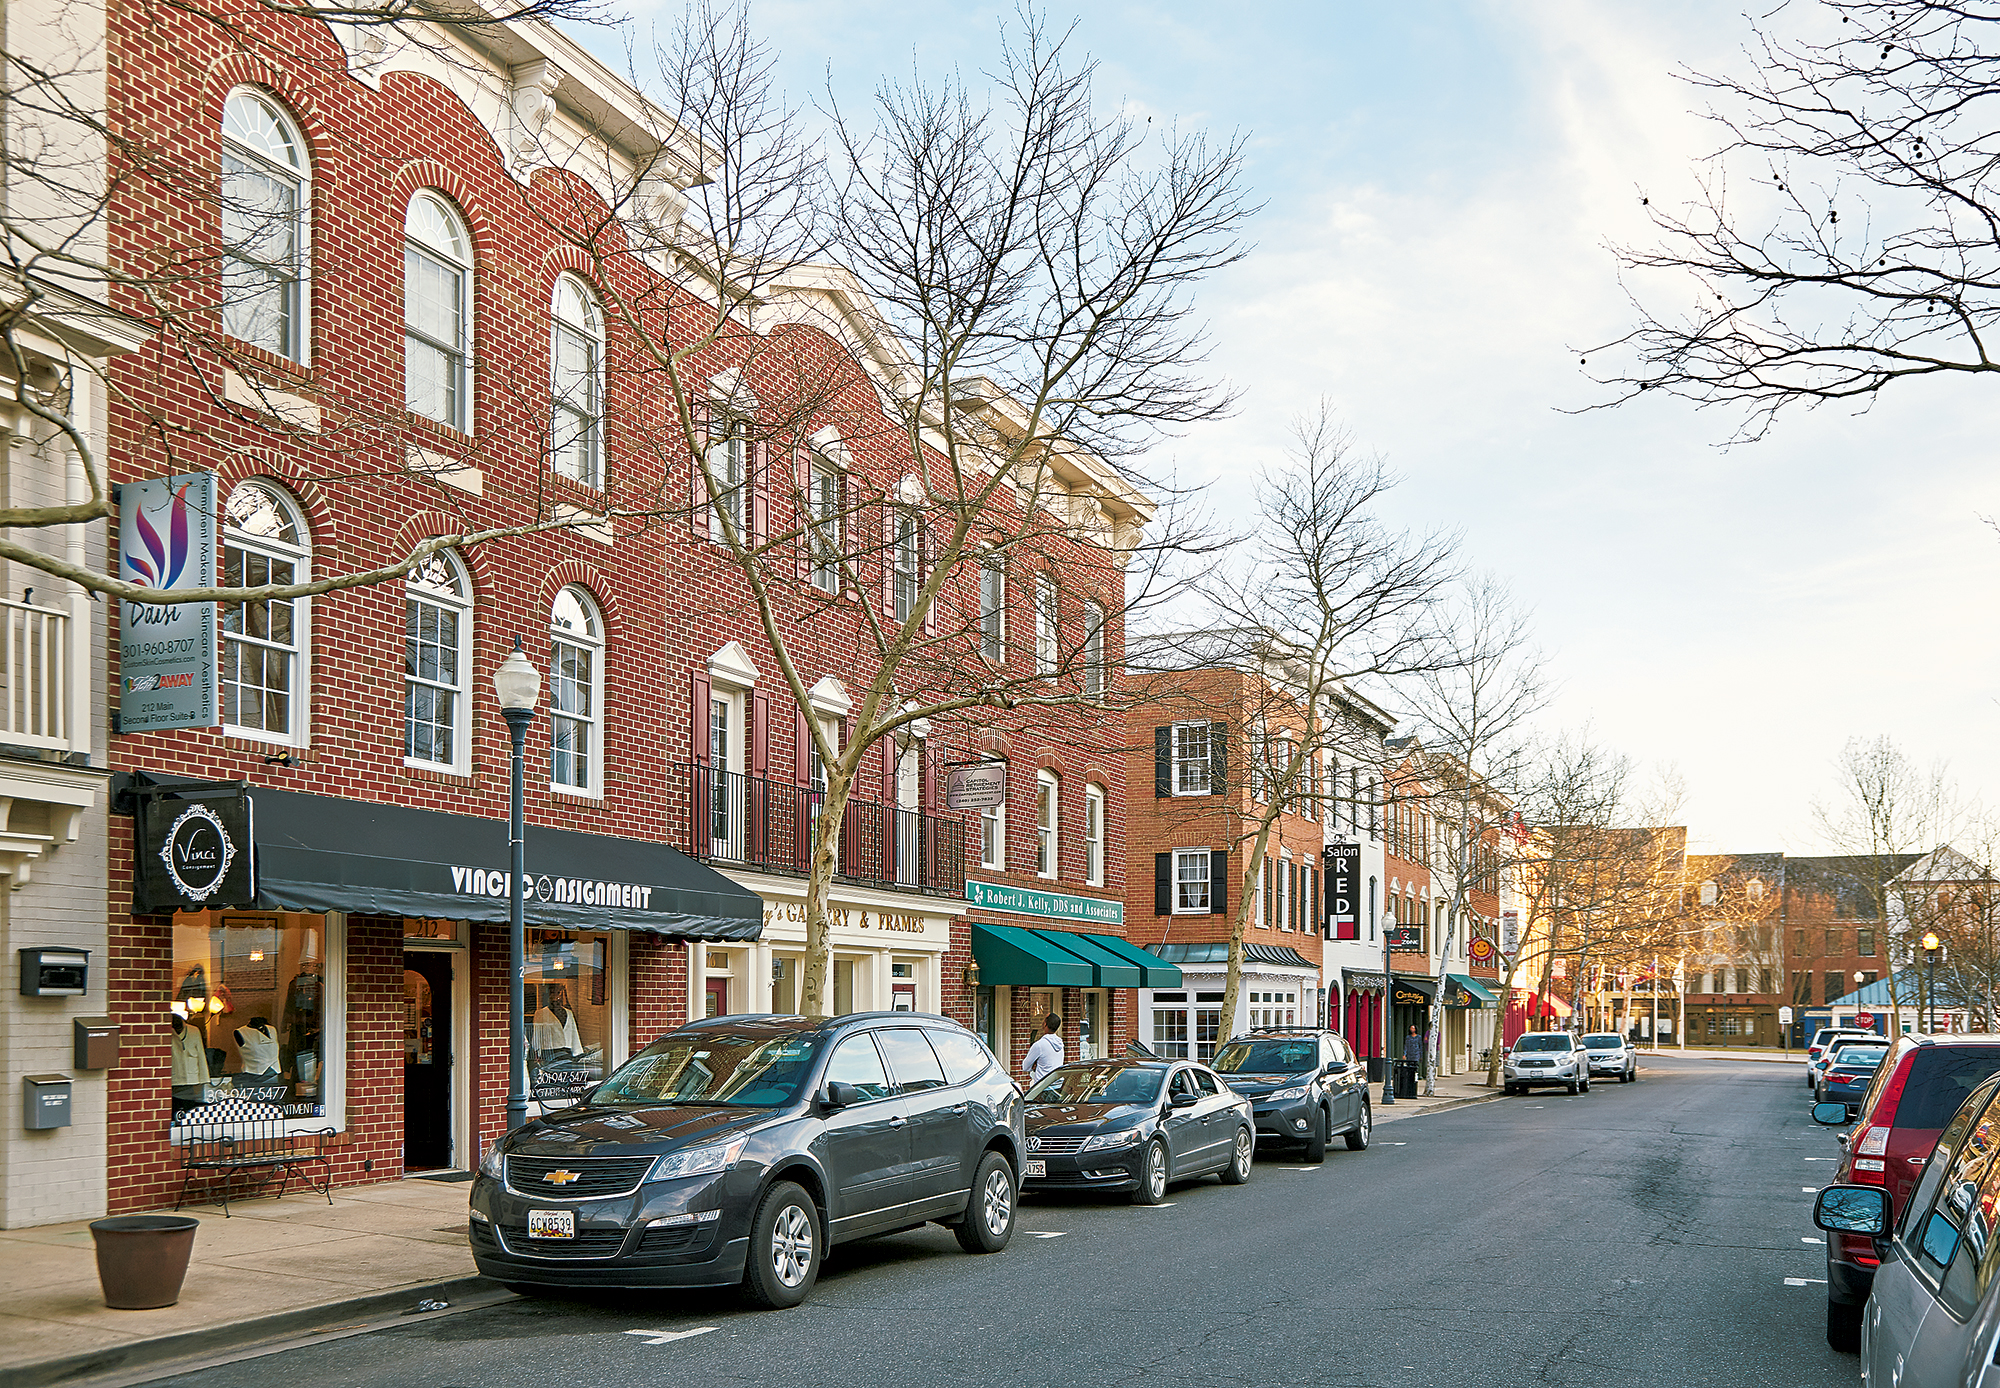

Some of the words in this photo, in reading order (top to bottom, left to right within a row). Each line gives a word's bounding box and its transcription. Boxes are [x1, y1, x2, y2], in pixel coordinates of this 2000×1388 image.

[200, 478, 211, 538] Permanent
[199, 542, 211, 588] Makeup
[201, 607, 211, 657] Skincare
[123, 638, 195, 658] 301-960-8707
[201, 661, 212, 719] Aesthetics
[123, 715, 149, 725] Second
[150, 713, 169, 723] Floor
[142, 703, 155, 713] 212
[156, 702, 174, 711] Main
[178, 828, 216, 862] Vinci
[1327, 846, 1358, 857] Salon
[450, 866, 511, 897] VINCI
[987, 889, 1016, 906] Robert
[1018, 894, 1025, 907] J.
[1028, 896, 1051, 914] Kelly,
[1053, 898, 1069, 913] DDS
[1070, 902, 1083, 915] and
[1085, 904, 1118, 919] Associates
[415, 919, 438, 937] 212
[860, 911, 869, 929] &
[878, 913, 924, 933] FRAMES
[1855, 1016, 1873, 1025] STOP
